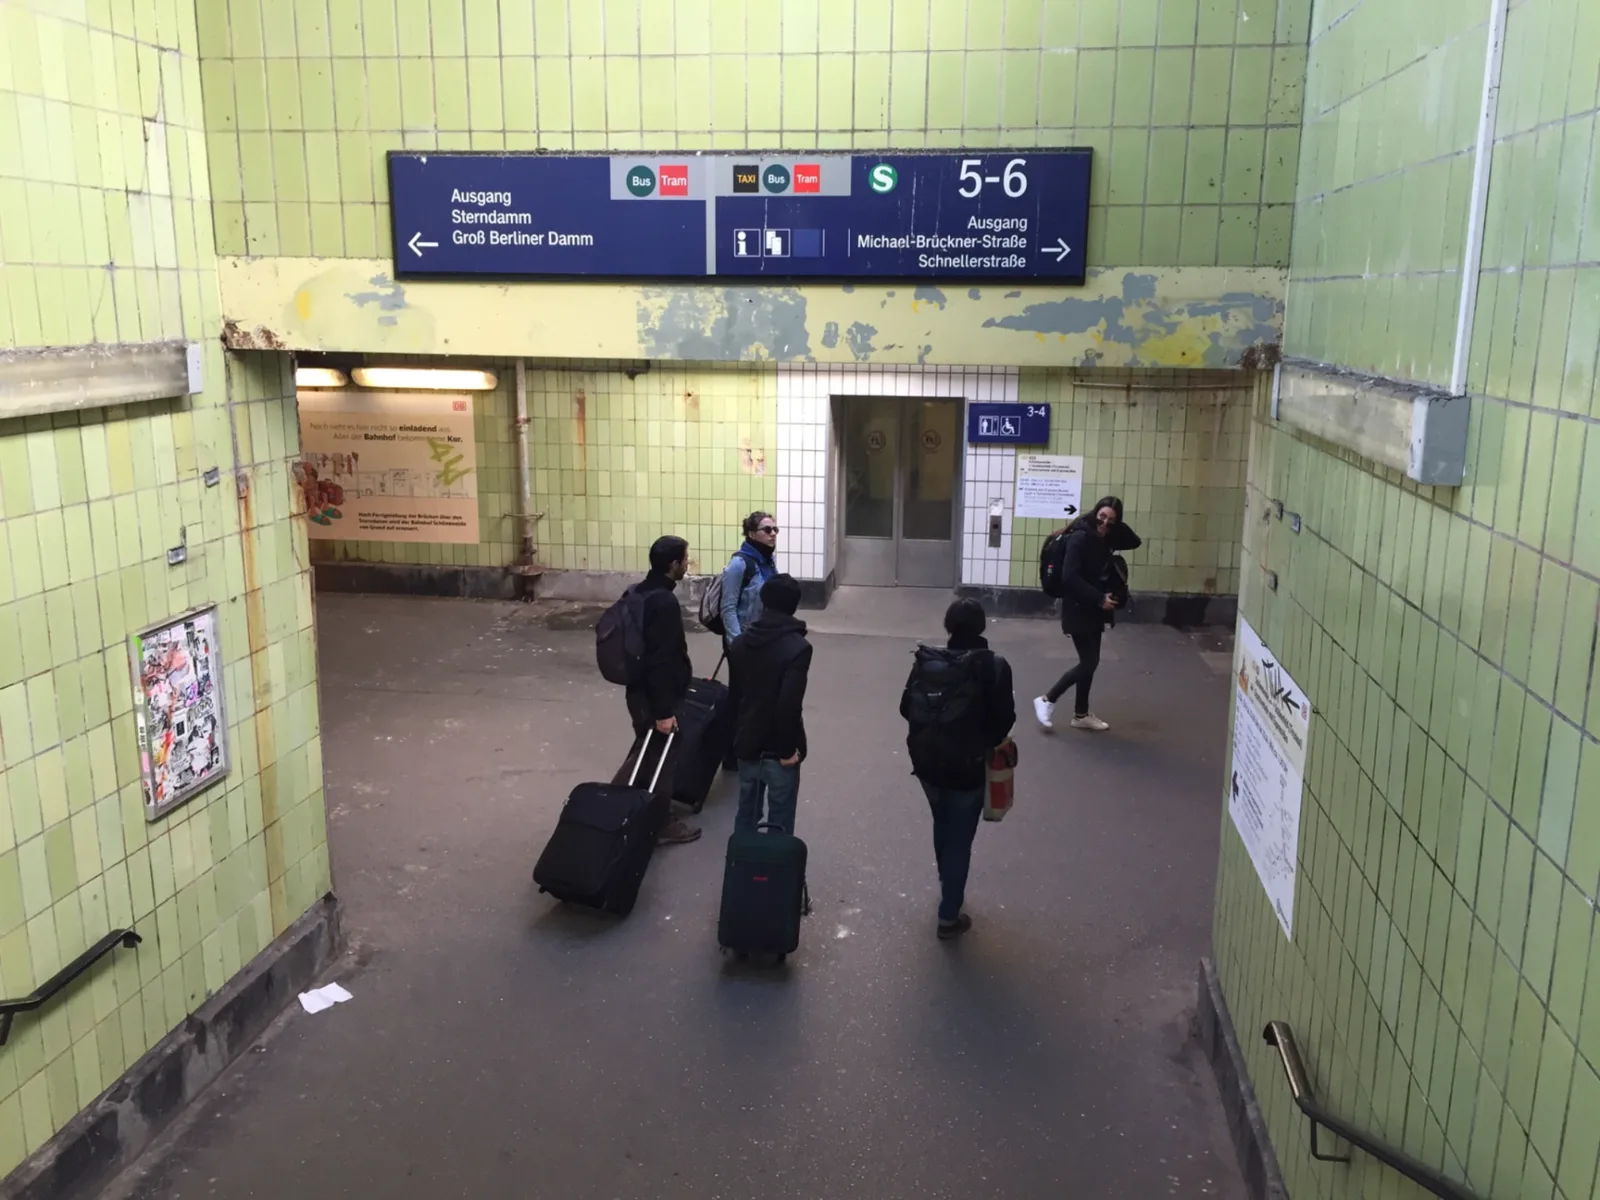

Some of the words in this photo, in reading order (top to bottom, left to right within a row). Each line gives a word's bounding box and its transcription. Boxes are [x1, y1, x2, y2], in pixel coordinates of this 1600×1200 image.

[632, 175, 651, 187] Bus
[661, 175, 688, 187] Tram
[736, 174, 756, 184] TAXI
[767, 173, 785, 184] Bus
[796, 173, 818, 184] Tram
[872, 165, 894, 192] S
[957, 158, 1028, 198] 5-6
[451, 188, 512, 207] Ausgang
[451, 209, 532, 224] Sterndamm
[967, 215, 1028, 232] Ausgang
[452, 229, 486, 245] Groß
[489, 230, 545, 245] Berliner
[548, 231, 594, 246] Damm
[857, 234, 1027, 250] Michael-Brückner-Straße
[918, 254, 1027, 268] Schnellerstraße
[1026, 405, 1046, 417] 3-4
[399, 423, 437, 433] einladend
[364, 432, 397, 441] Bahnhof
